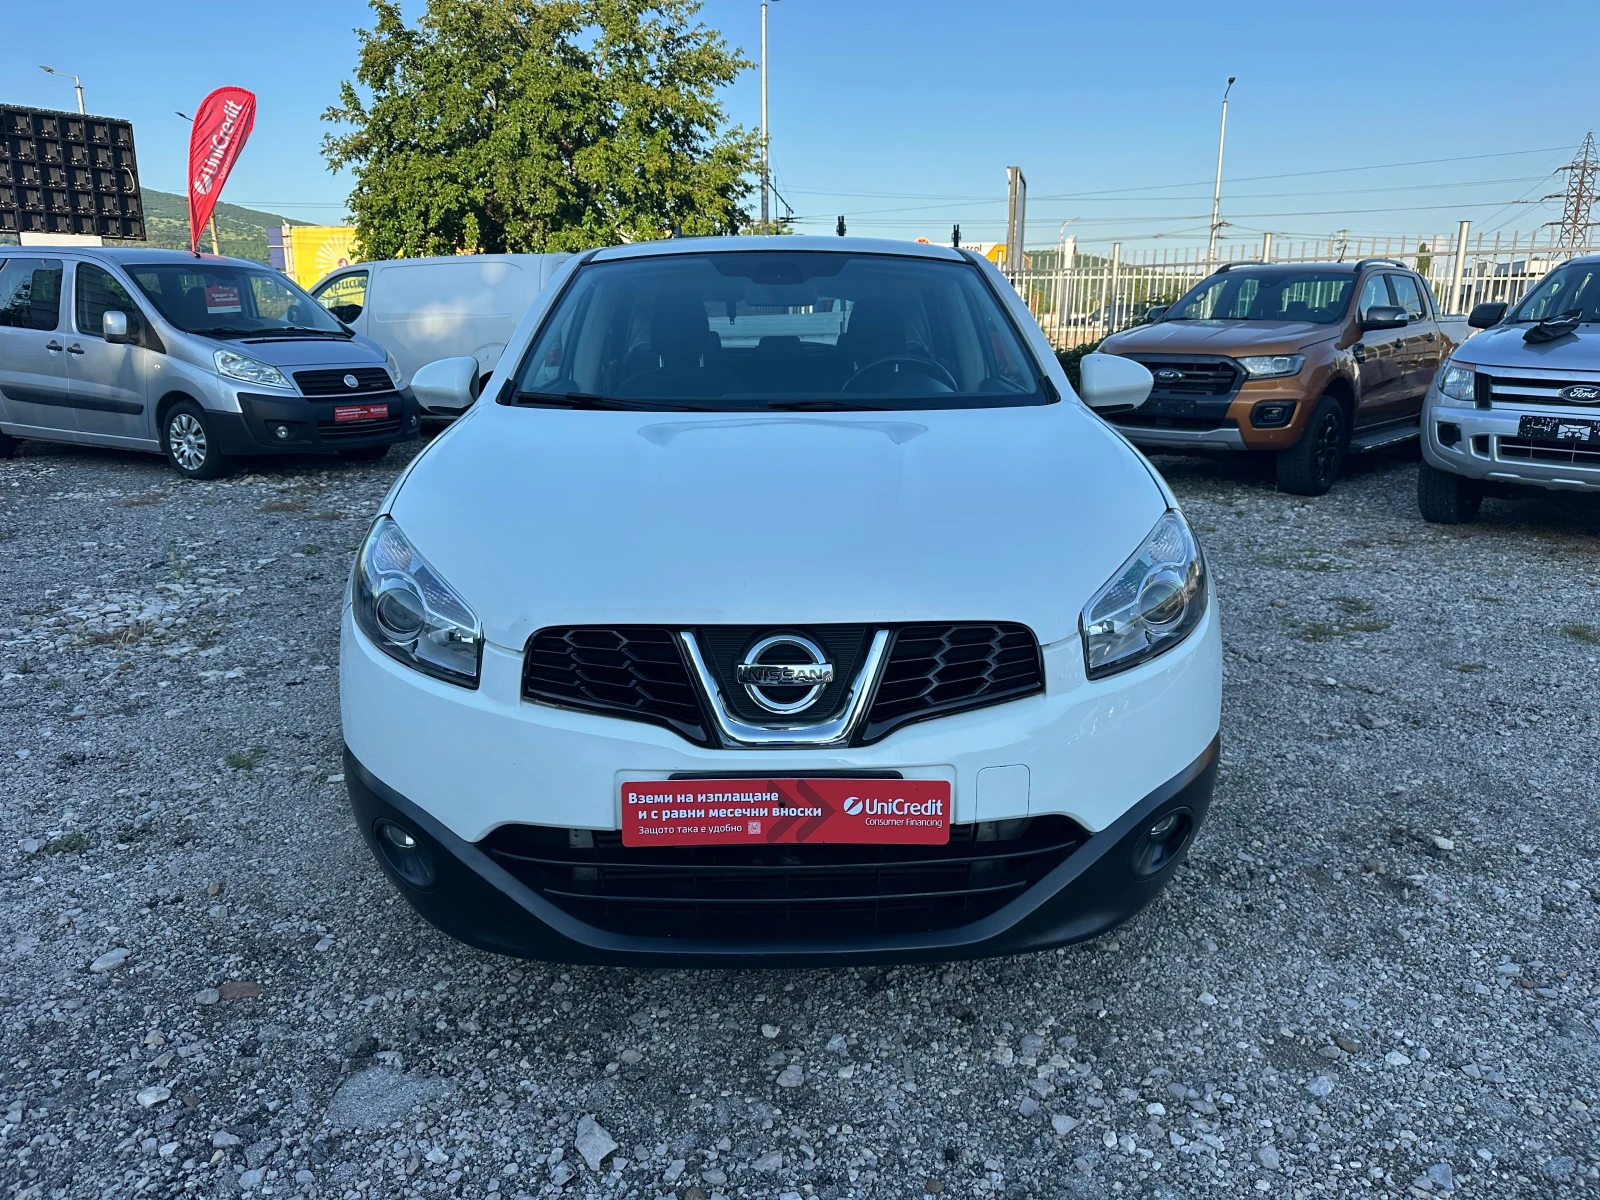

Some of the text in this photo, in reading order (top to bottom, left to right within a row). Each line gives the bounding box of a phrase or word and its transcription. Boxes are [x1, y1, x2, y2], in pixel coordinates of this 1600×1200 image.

[201, 99, 243, 175] UniCredit
[1569, 387, 1598, 399] Ford
[748, 668, 823, 682] NISSAN
[629, 792, 779, 804] Вземи на изплащане
[865, 798, 943, 816] UniCredit
[638, 806, 822, 822] и с равни месечни вноски
[638, 826, 675, 835] Защото
[677, 826, 699, 834] така
[708, 824, 743, 835] удобно
[865, 817, 943, 829] Consumer Financing
